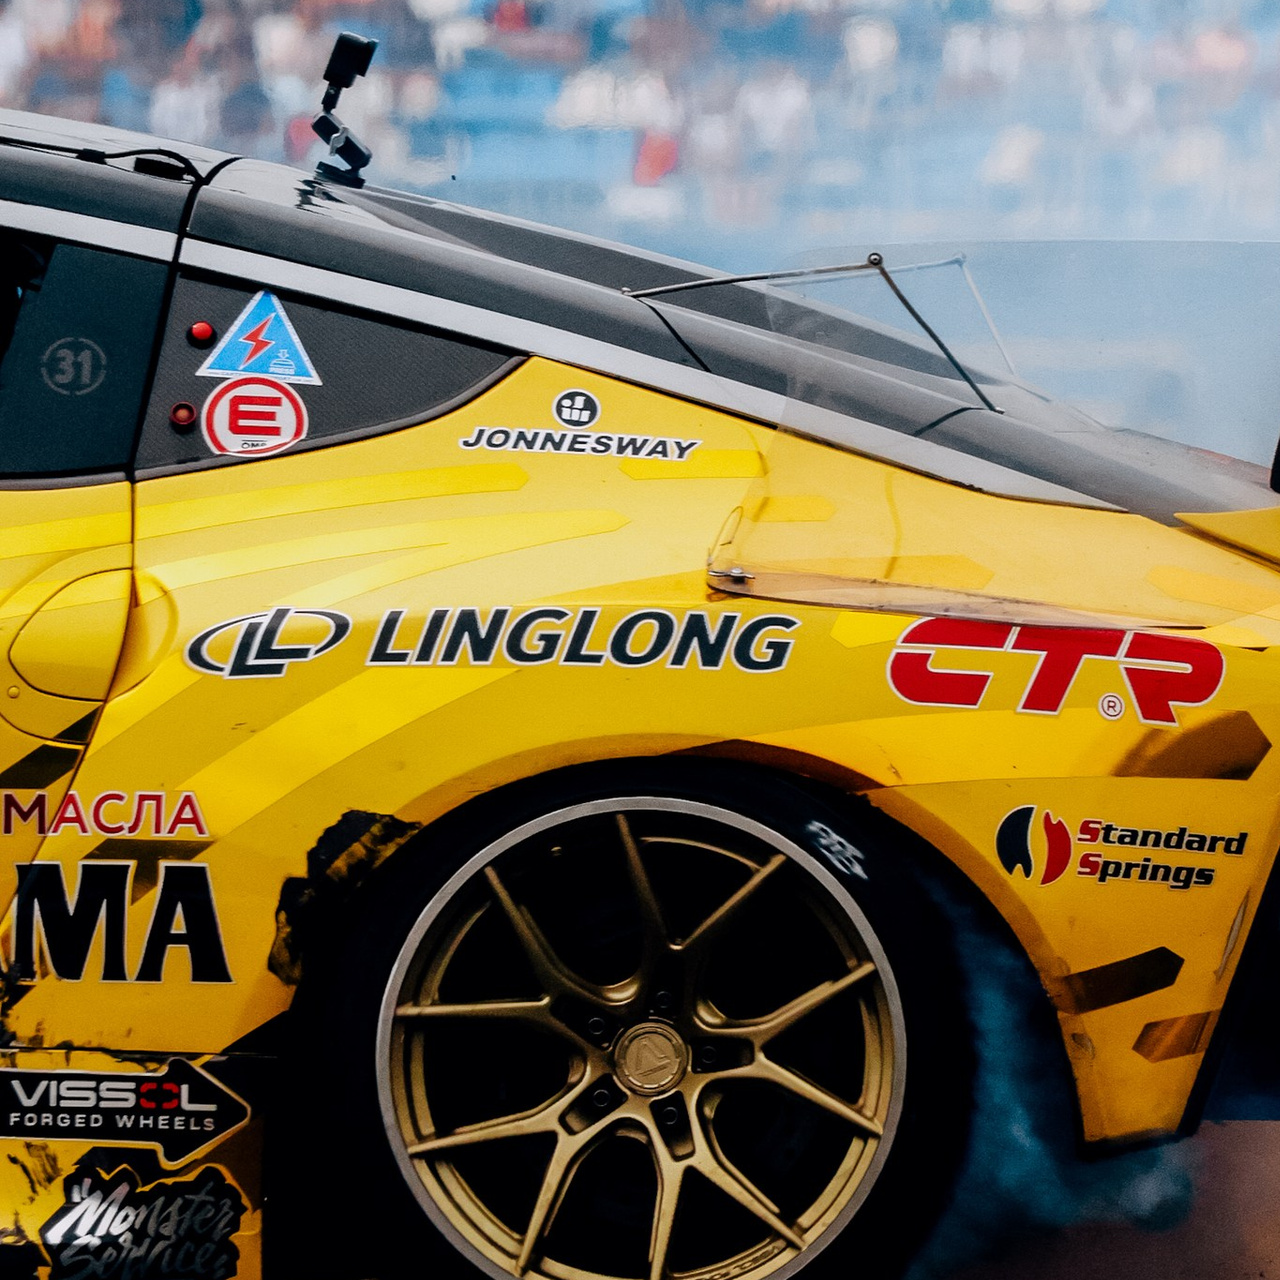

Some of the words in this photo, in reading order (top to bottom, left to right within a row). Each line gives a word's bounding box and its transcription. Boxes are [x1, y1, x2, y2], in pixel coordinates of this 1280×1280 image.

[55, 349, 94, 385] 31
[228, 395, 282, 436] E
[462, 427, 699, 460] JONNESWAY
[369, 607, 799, 671] LINGLONG
[889, 617, 1224, 725] CTR
[2, 792, 208, 836] МАСЛА
[1076, 819, 1249, 856] Standard
[1076, 852, 1216, 891] Springs
[0, 862, 235, 983] MA
[10, 1079, 218, 1112] VISSOL
[8, 1112, 104, 1128] FORGED
[115, 1114, 216, 1131] WHEELS
[45, 1180, 236, 1245] Monster
